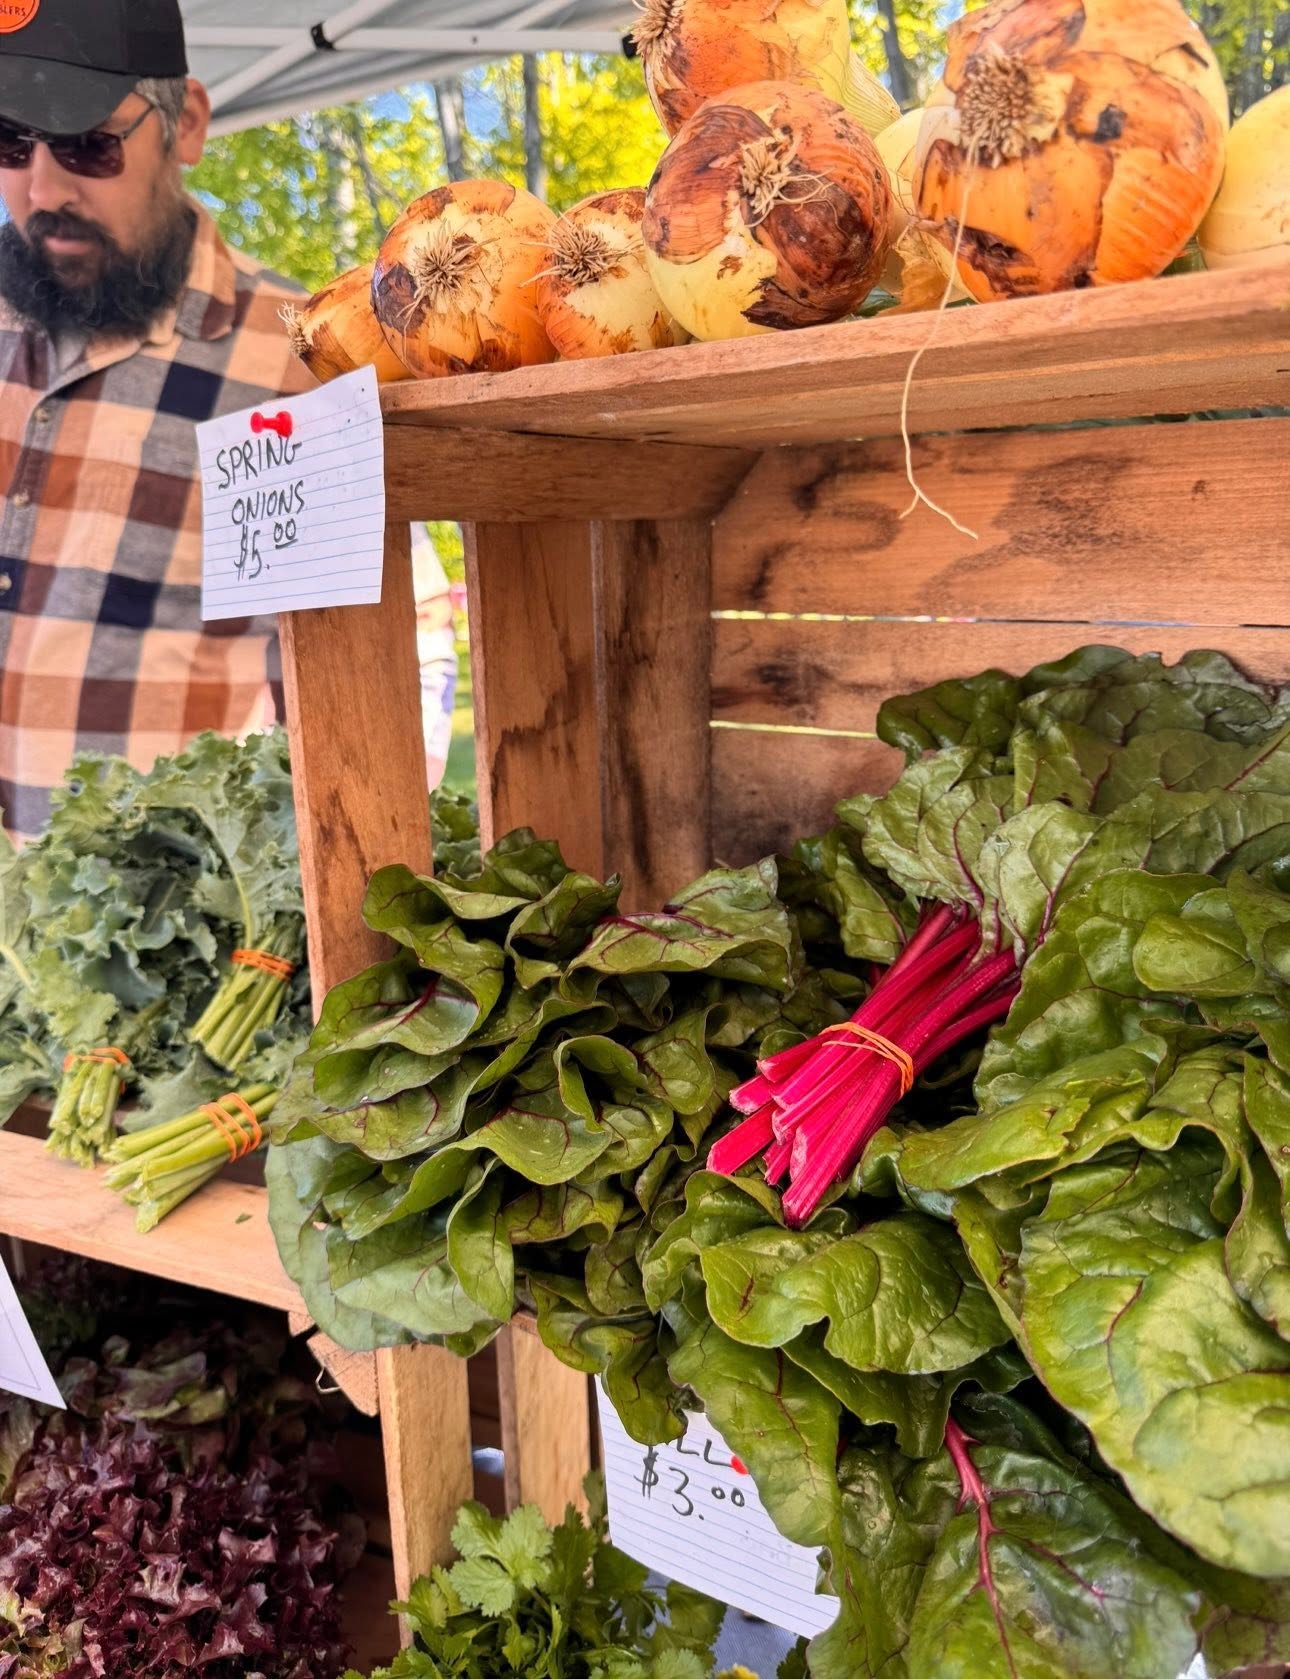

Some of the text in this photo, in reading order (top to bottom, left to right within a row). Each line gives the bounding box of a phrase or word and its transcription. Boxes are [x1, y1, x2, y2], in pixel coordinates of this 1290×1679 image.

[216, 436, 302, 489] SPRING
[232, 480, 305, 525] ONIONS
[234, 519, 299, 582] $5.00
[665, 1437, 732, 1468] LL
[633, 1446, 746, 1521] $3.00
